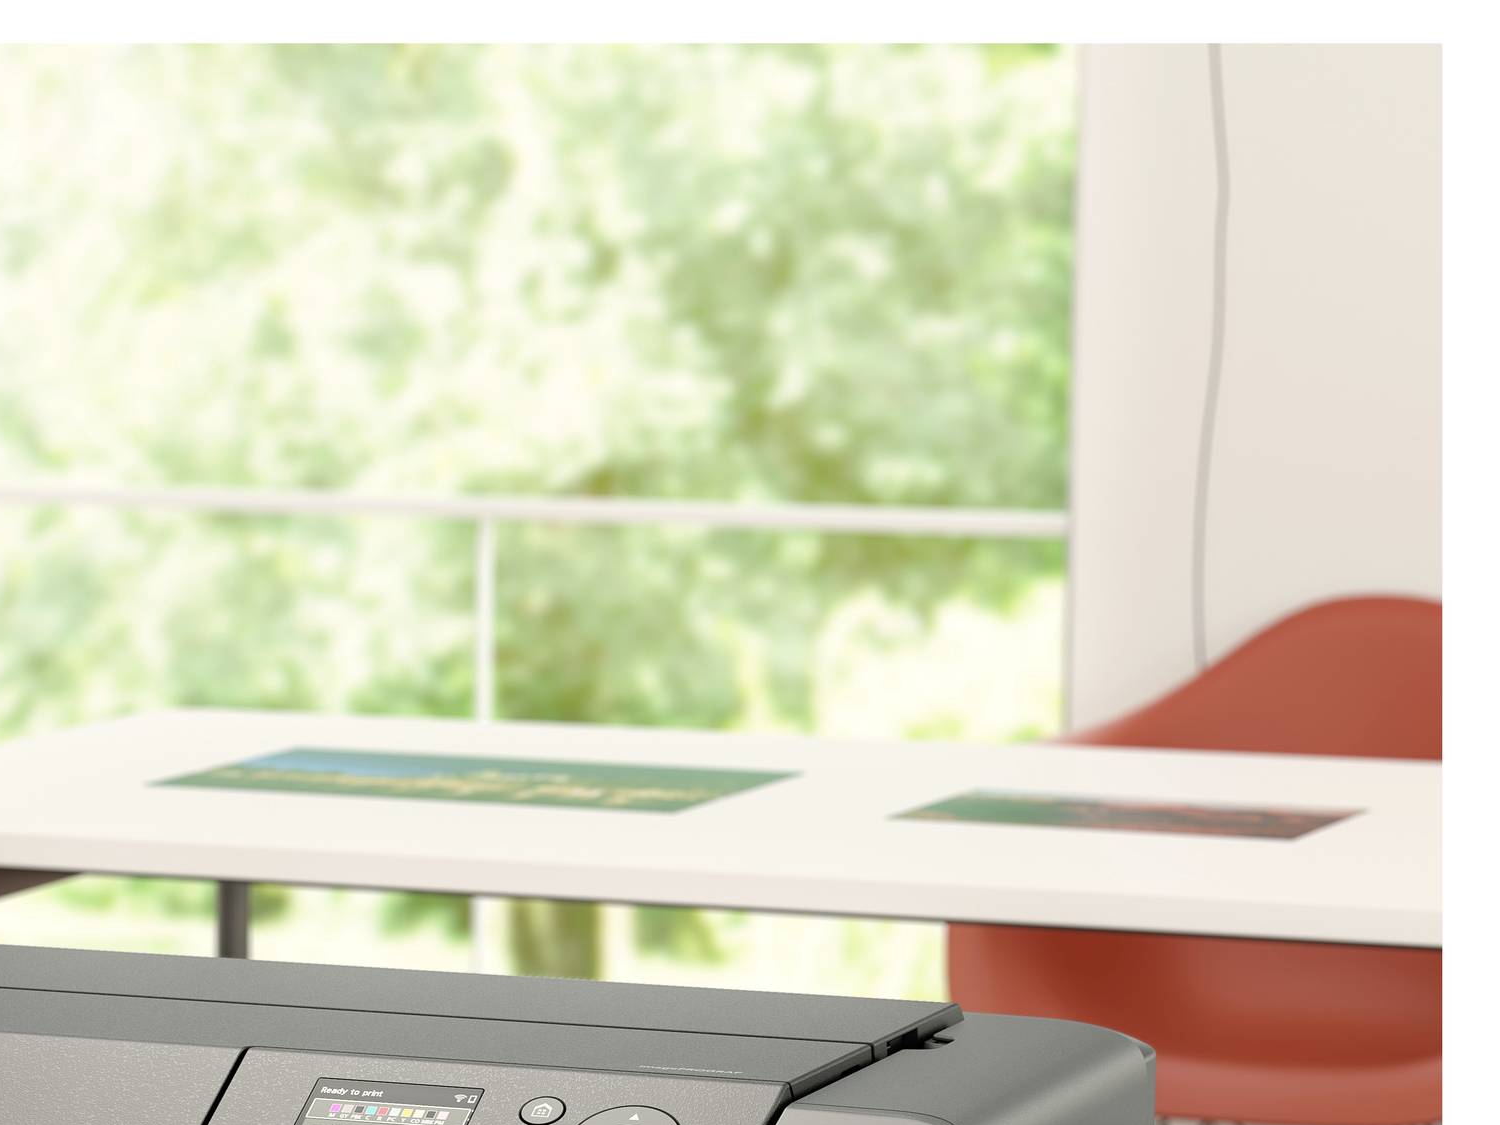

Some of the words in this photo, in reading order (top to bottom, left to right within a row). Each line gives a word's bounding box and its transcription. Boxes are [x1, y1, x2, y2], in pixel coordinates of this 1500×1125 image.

[320, 1086, 348, 1097] Ready
[350, 1088, 360, 1096] to
[361, 1089, 384, 1098] print
